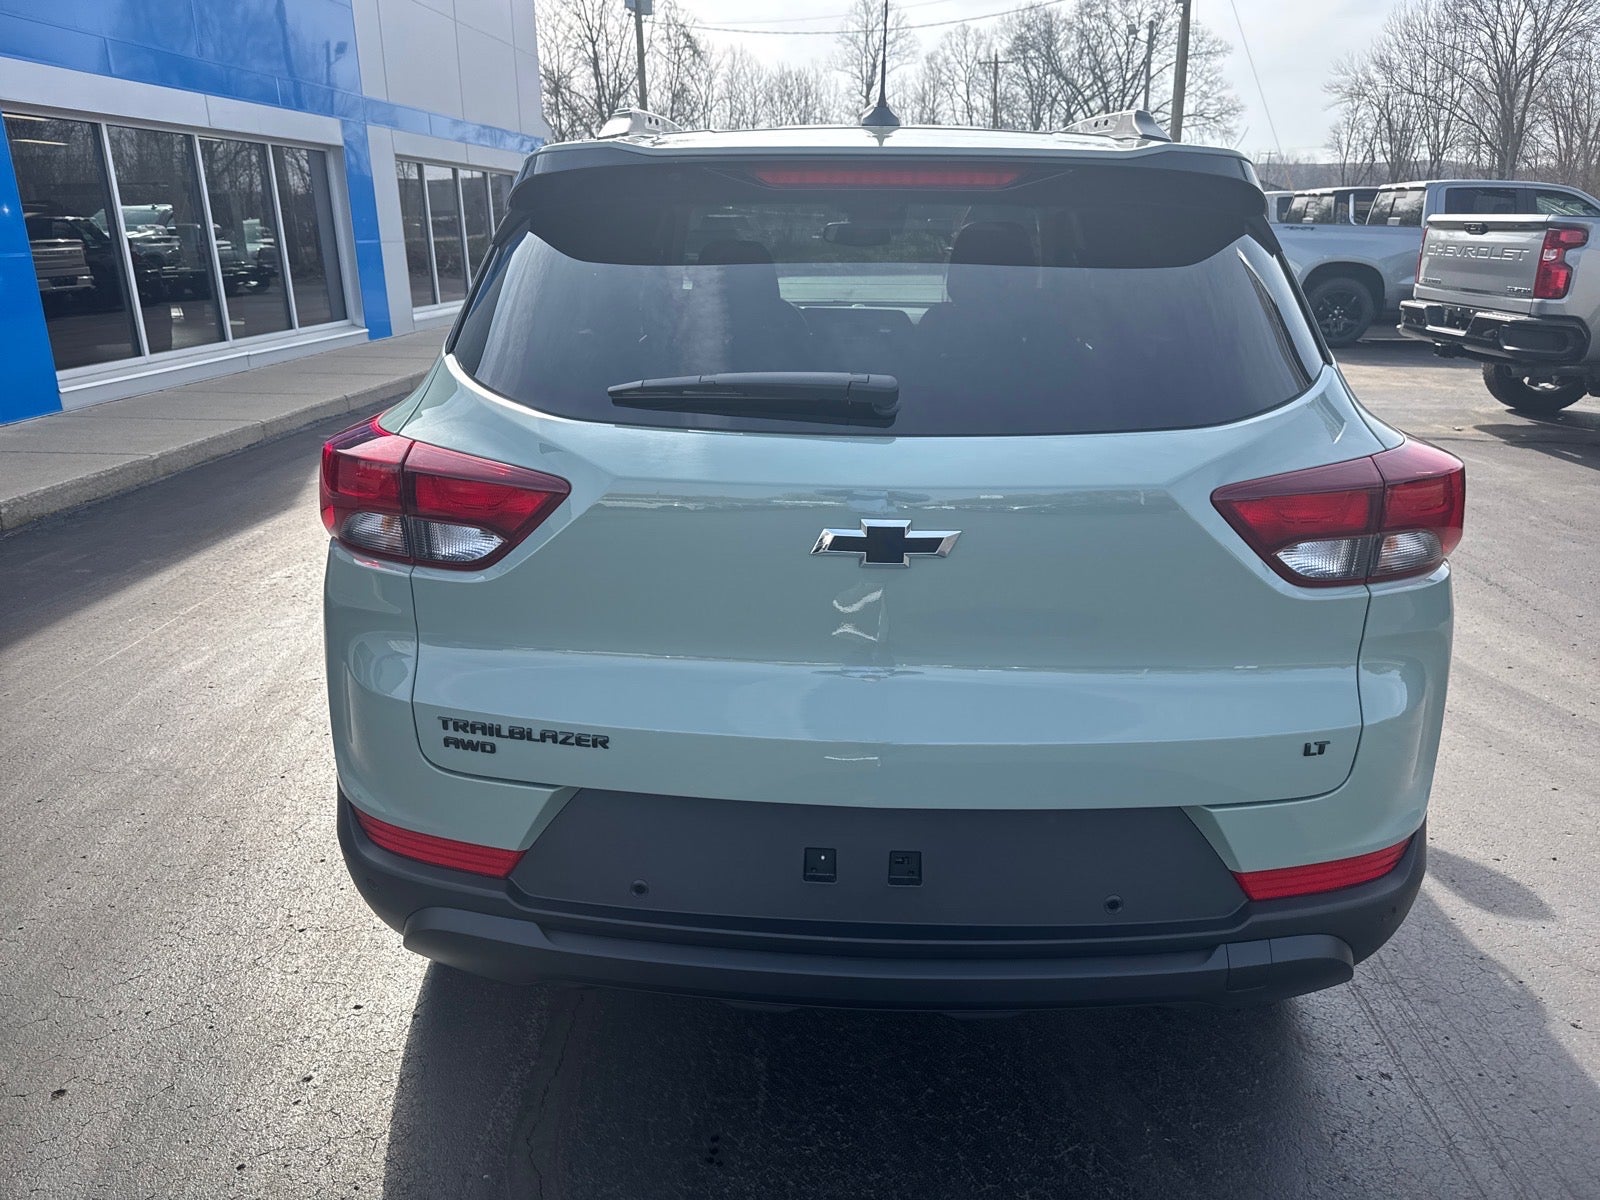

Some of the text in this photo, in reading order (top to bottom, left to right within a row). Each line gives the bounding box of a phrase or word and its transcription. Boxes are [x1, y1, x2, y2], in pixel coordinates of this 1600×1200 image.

[1427, 243, 1530, 261] CHEVROLET
[438, 716, 610, 750] TRAILBLAZER
[443, 736, 497, 754] AWD
[1303, 740, 1331, 757] LT
